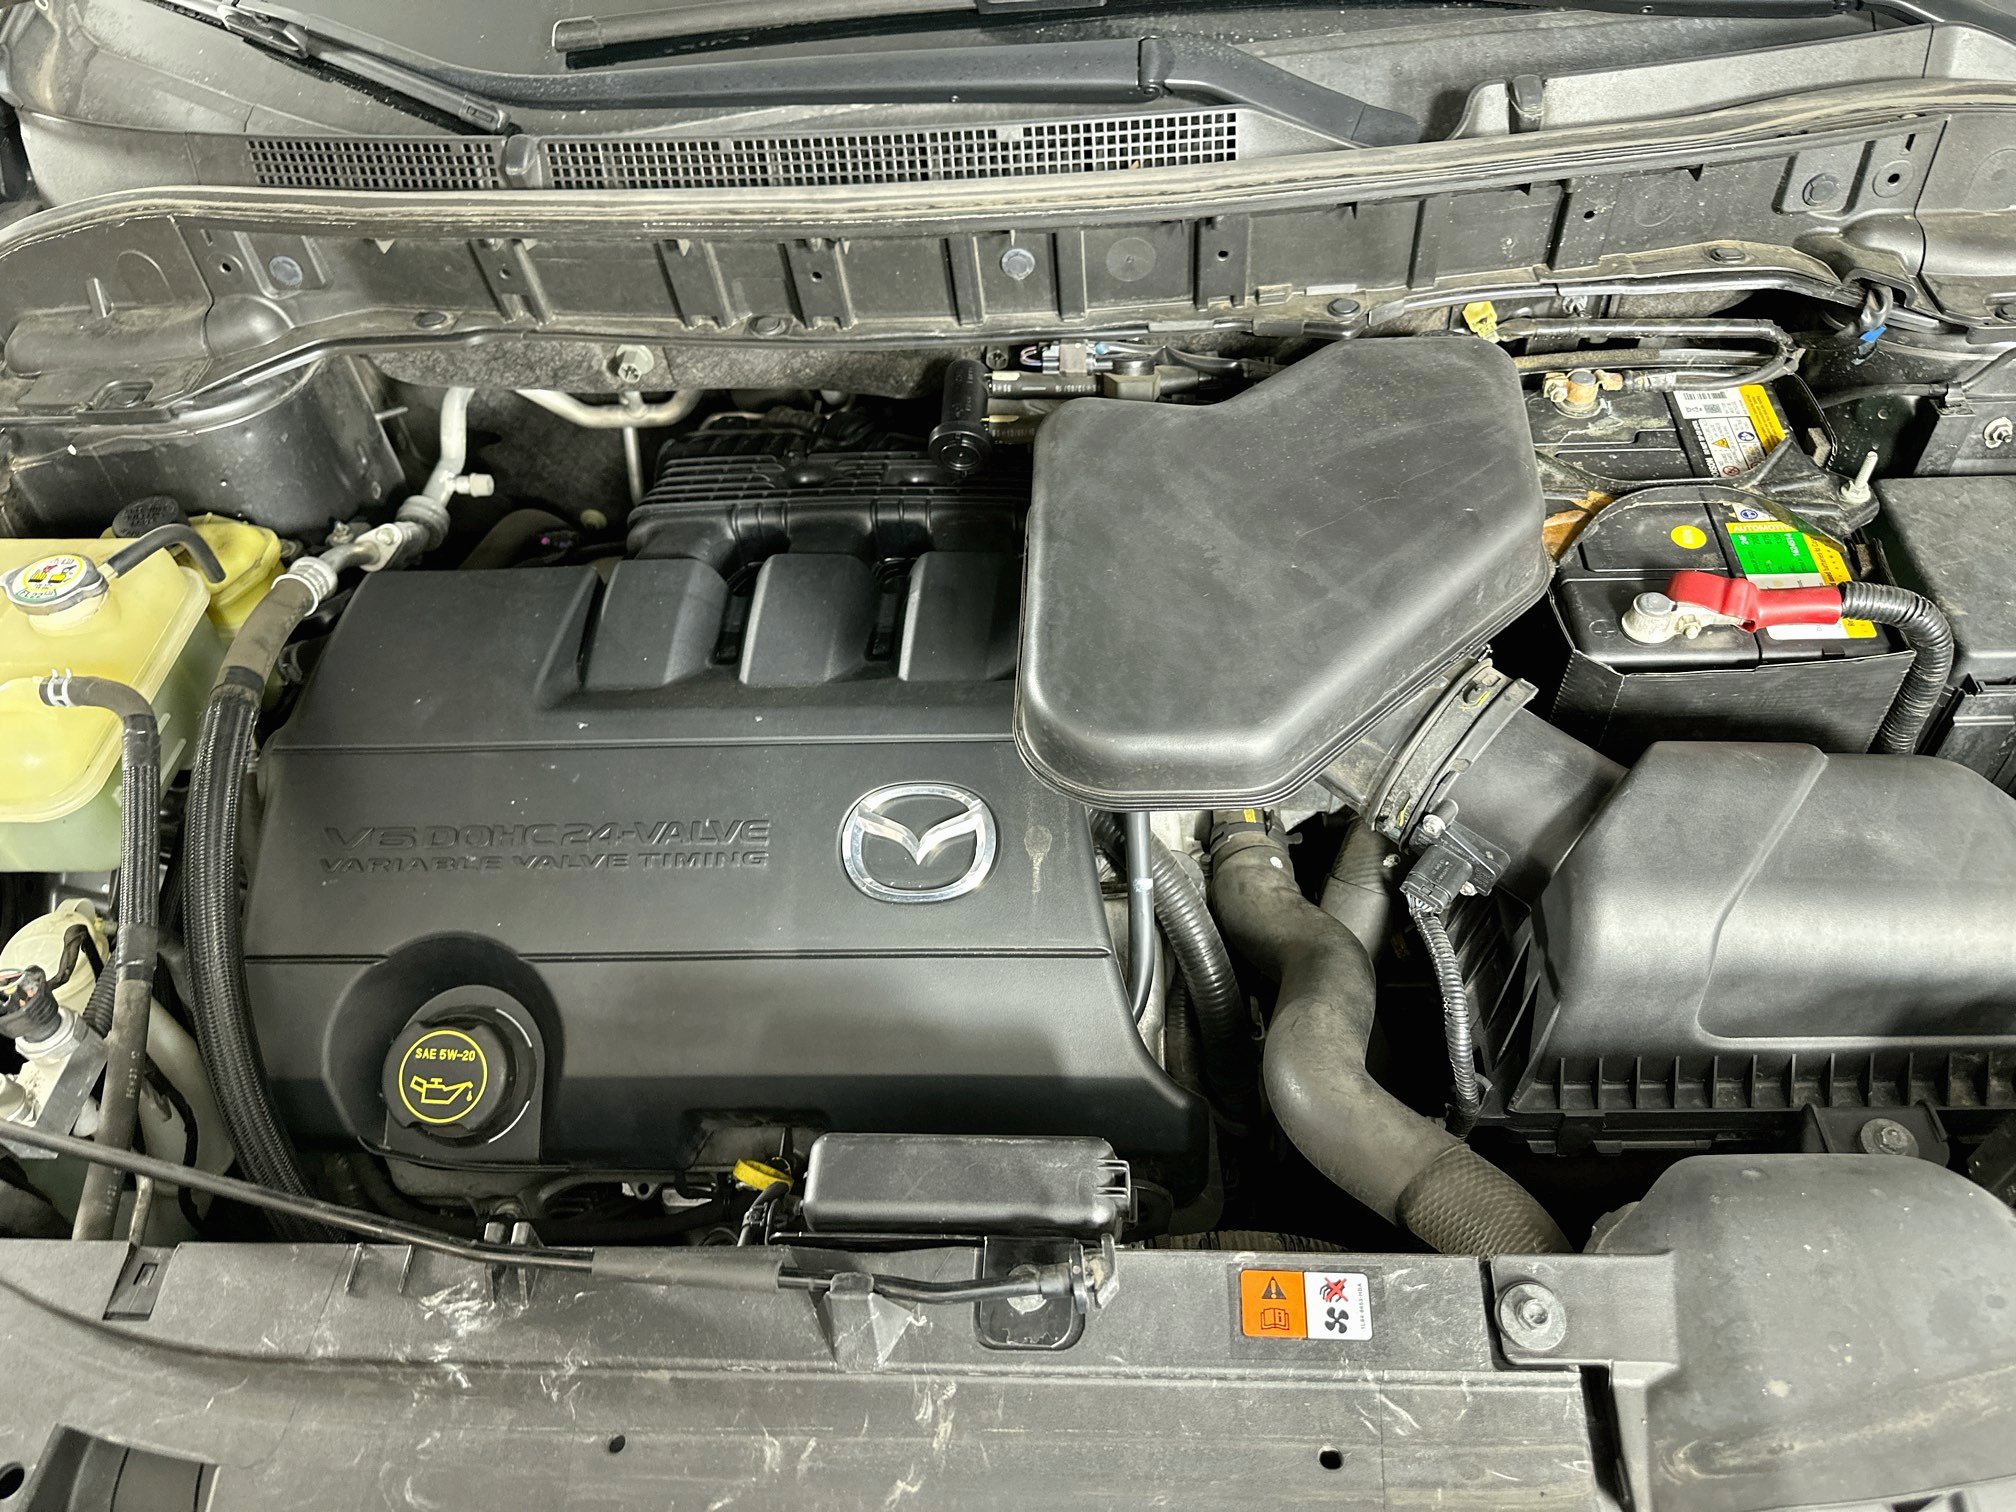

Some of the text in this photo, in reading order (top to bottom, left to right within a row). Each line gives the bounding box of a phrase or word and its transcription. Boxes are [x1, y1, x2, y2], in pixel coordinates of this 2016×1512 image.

[1733, 524, 1792, 532] AUTOMOTIV
[324, 819, 770, 850] V6 DOHC 24-VALVE
[319, 850, 770, 873] VARIABLE VALVE TIMING
[415, 1048, 476, 1061] SAE 5W-20
